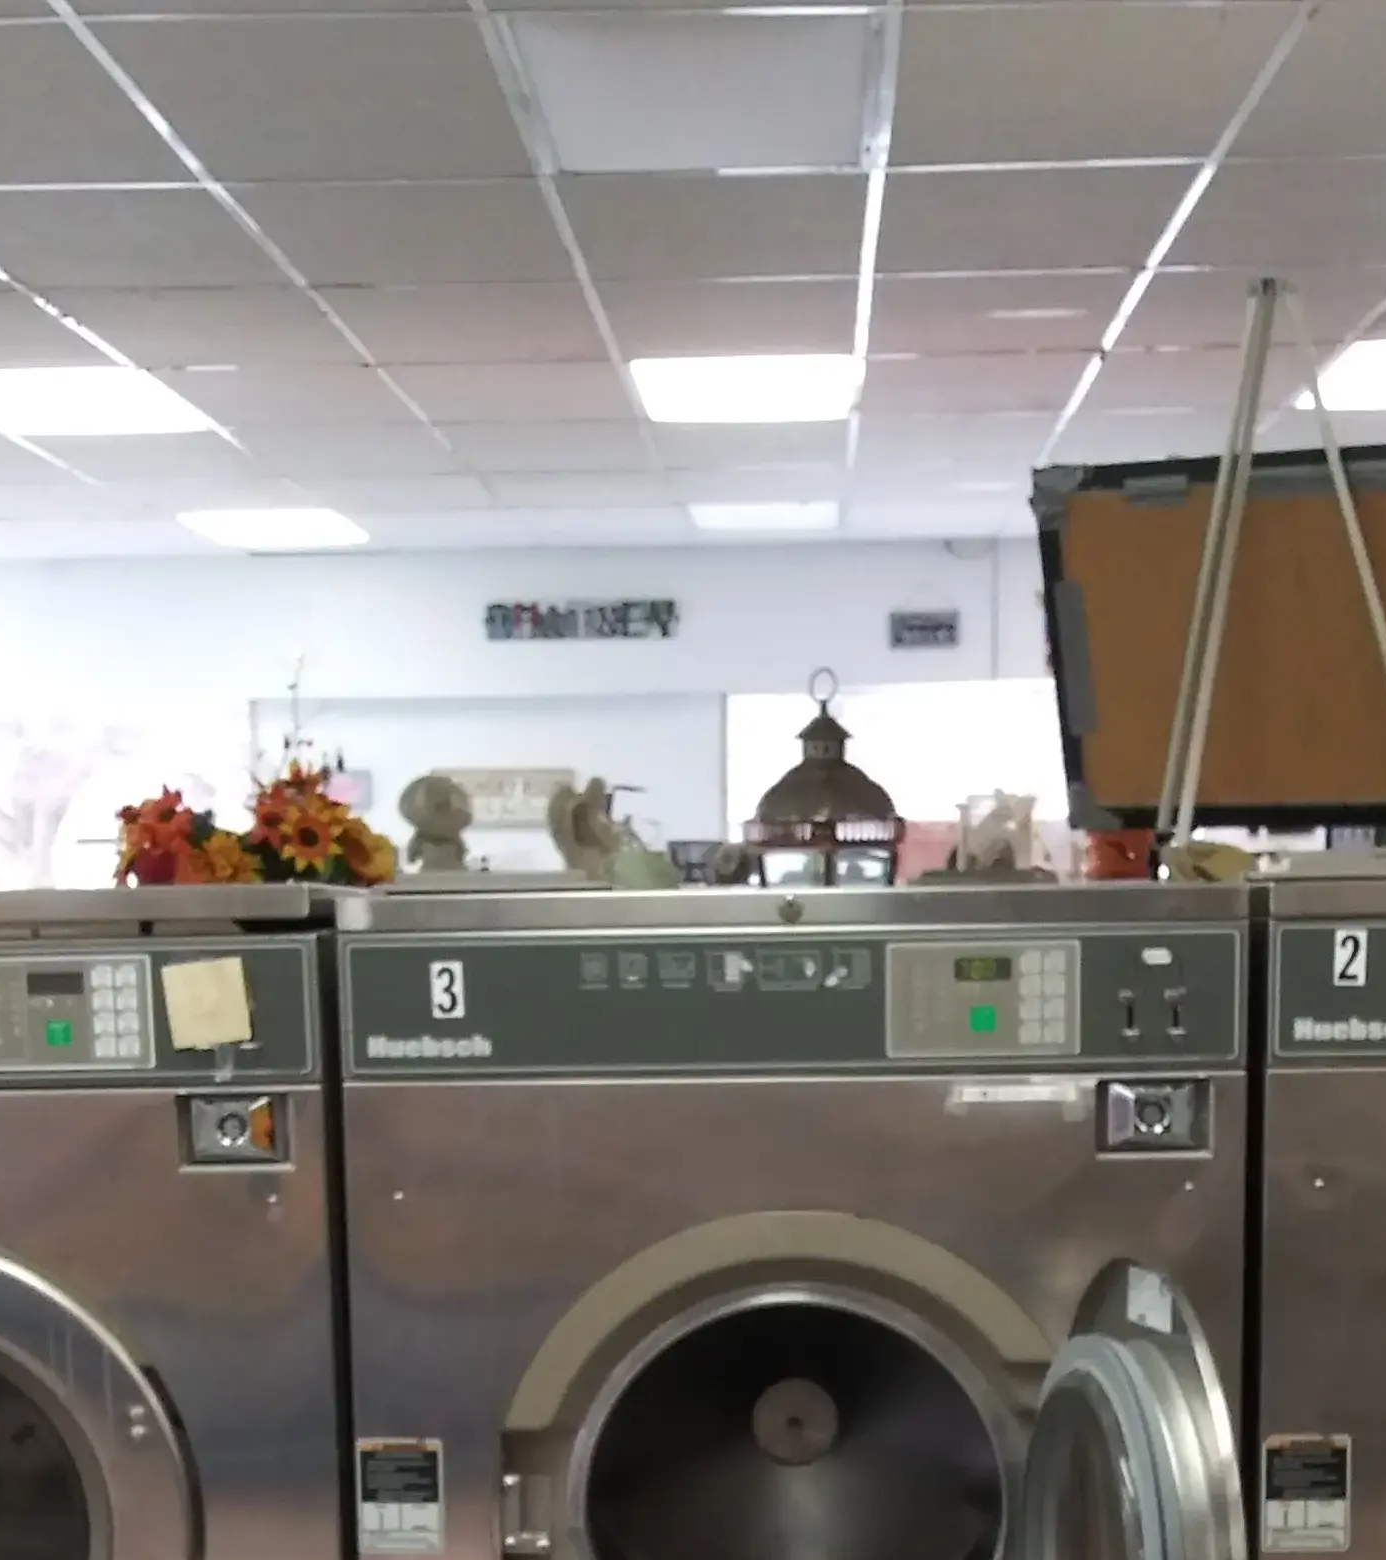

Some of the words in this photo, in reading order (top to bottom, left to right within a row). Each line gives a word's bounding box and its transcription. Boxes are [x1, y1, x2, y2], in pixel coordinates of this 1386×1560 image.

[1338, 935, 1361, 980] 2
[436, 967, 457, 1014] 3
[367, 1034, 493, 1059] Huebsch
